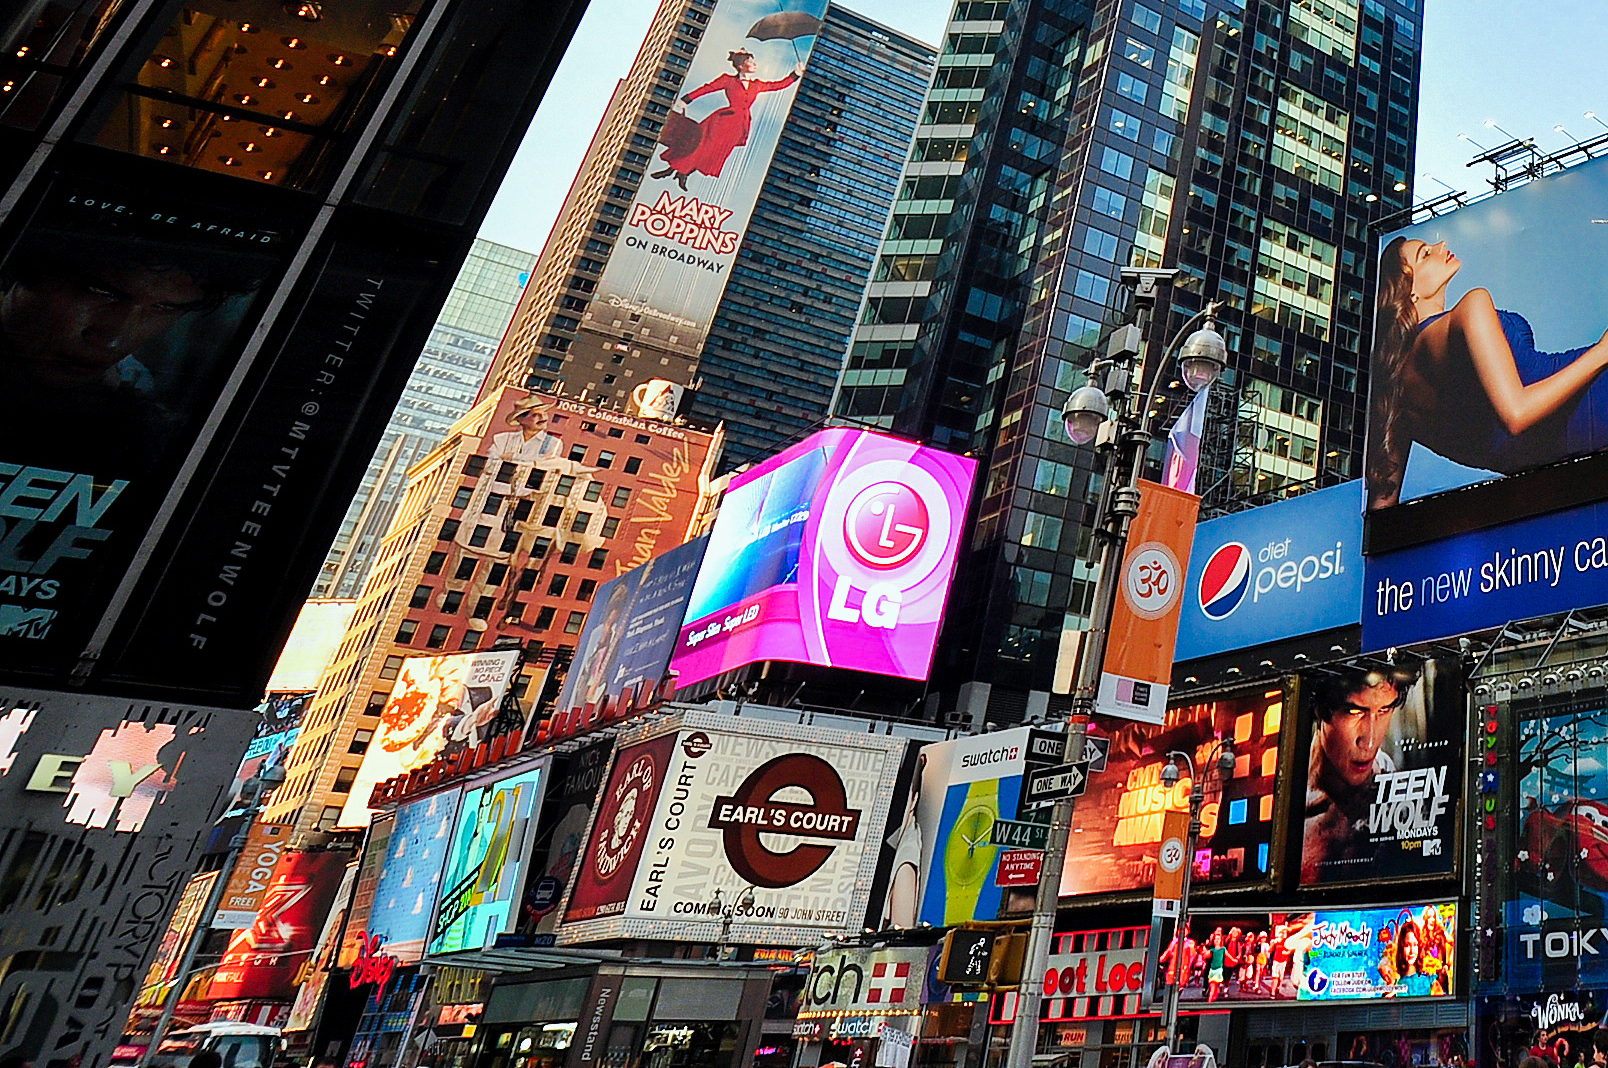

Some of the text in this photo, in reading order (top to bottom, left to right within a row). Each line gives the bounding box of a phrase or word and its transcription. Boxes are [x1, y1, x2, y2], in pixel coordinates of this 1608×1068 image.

[653, 190, 734, 230] MARY
[150, 212, 178, 225] BE
[190, 220, 273, 245] AFRAID
[629, 203, 739, 255] POPPINS
[625, 236, 725, 274] ON BROADWAY
[556, 400, 647, 431] 100% Colombian
[629, 436, 690, 524] Valdez
[1258, 537, 1292, 561] diet
[1252, 541, 1342, 604] pepsi
[1376, 577, 1415, 616] the
[1420, 568, 1473, 608] new
[1480, 547, 1565, 594] skinny
[826, 574, 903, 631] LG
[686, 631, 706, 647] Super
[705, 621, 722, 639] Slim
[722, 613, 745, 632] Super
[743, 603, 761, 624] LED
[485, 665, 504, 673] PIECE
[961, 746, 1009, 769] swatch
[1038, 740, 1063, 756] ONE
[1418, 739, 1449, 750] AFRAID
[615, 759, 645, 802] EARL
[1036, 772, 1079, 792] ONE WAY
[1126, 762, 1164, 792] CMT
[1374, 765, 1448, 805] TEEN
[718, 804, 854, 834] EARL'S COURT
[1368, 794, 1450, 835] WOLF
[640, 835, 675, 913] EARL'S
[664, 760, 698, 832] COURT
[1396, 825, 1439, 841] MONDAYS
[1400, 840, 1422, 852] 10pm
[1422, 838, 1442, 857] MTV
[244, 841, 286, 895] YOGA
[1002, 851, 1044, 862] NO STANDING
[1004, 862, 1035, 871] ANYTIME
[228, 896, 257, 908] FREE!
[437, 898, 461, 934] SHOP
[778, 907, 789, 919] 90
[790, 908, 814, 920] JOHN
[815, 909, 848, 923] STREET
[1312, 920, 1372, 949] Judy Moody
[580, 986, 612, 1063] Newsstand
[1531, 993, 1585, 1030] WONKA
[1062, 1031, 1085, 1042] RUN
